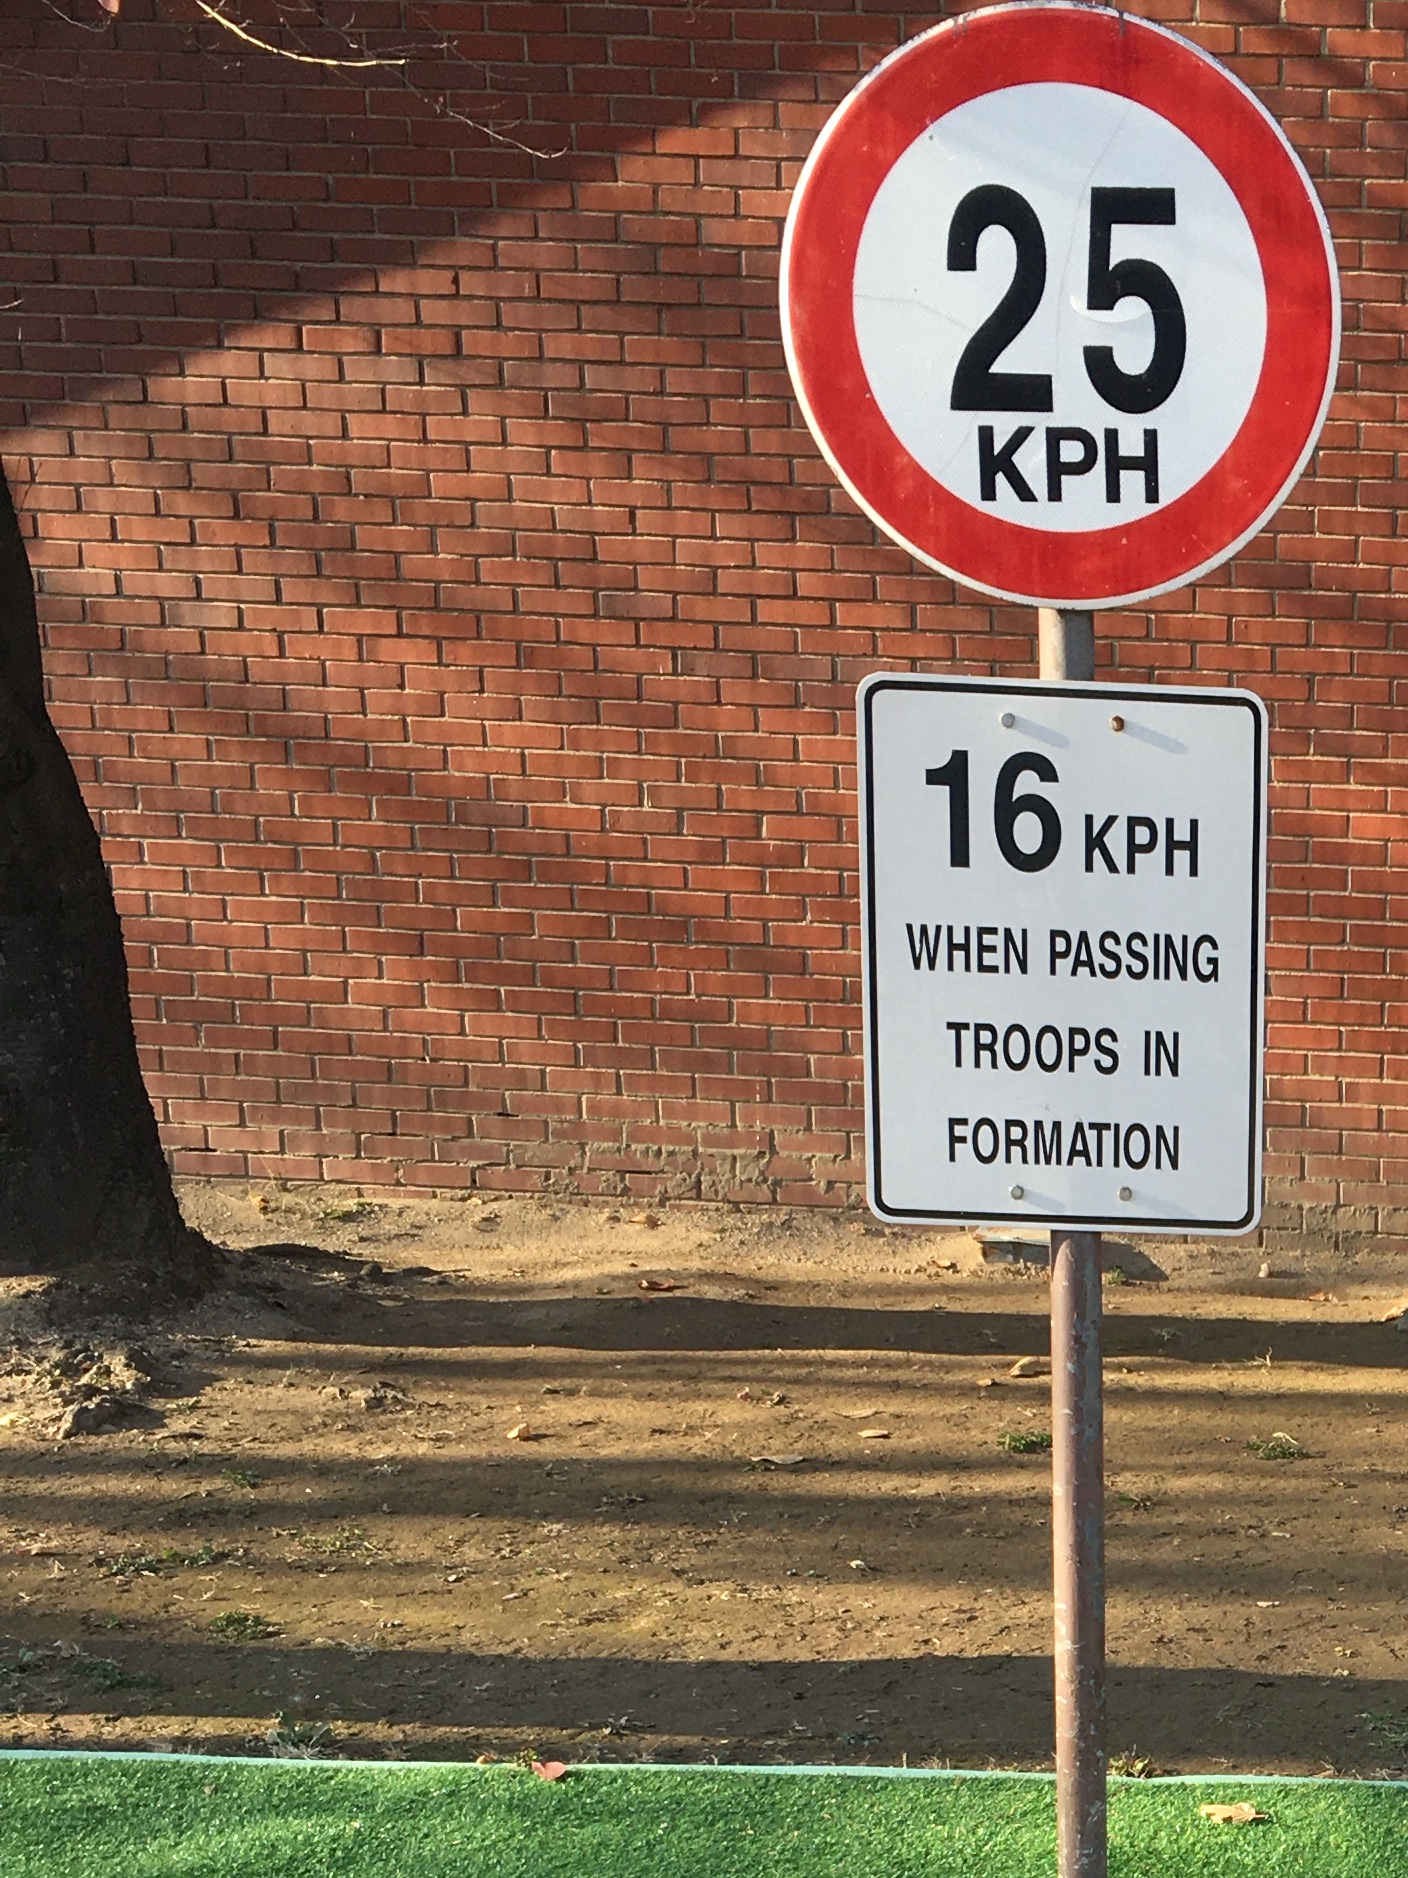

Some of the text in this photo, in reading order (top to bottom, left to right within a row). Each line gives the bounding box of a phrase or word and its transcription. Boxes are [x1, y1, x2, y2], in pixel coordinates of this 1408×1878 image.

[946, 183, 1187, 415] 25
[977, 424, 1160, 504] KPH
[924, 748, 1199, 878] 16 KPH
[905, 922, 1220, 984] WHEN PASSING
[945, 1021, 1181, 1078] TROOPS IN
[947, 1117, 1181, 1171] FORMATION
